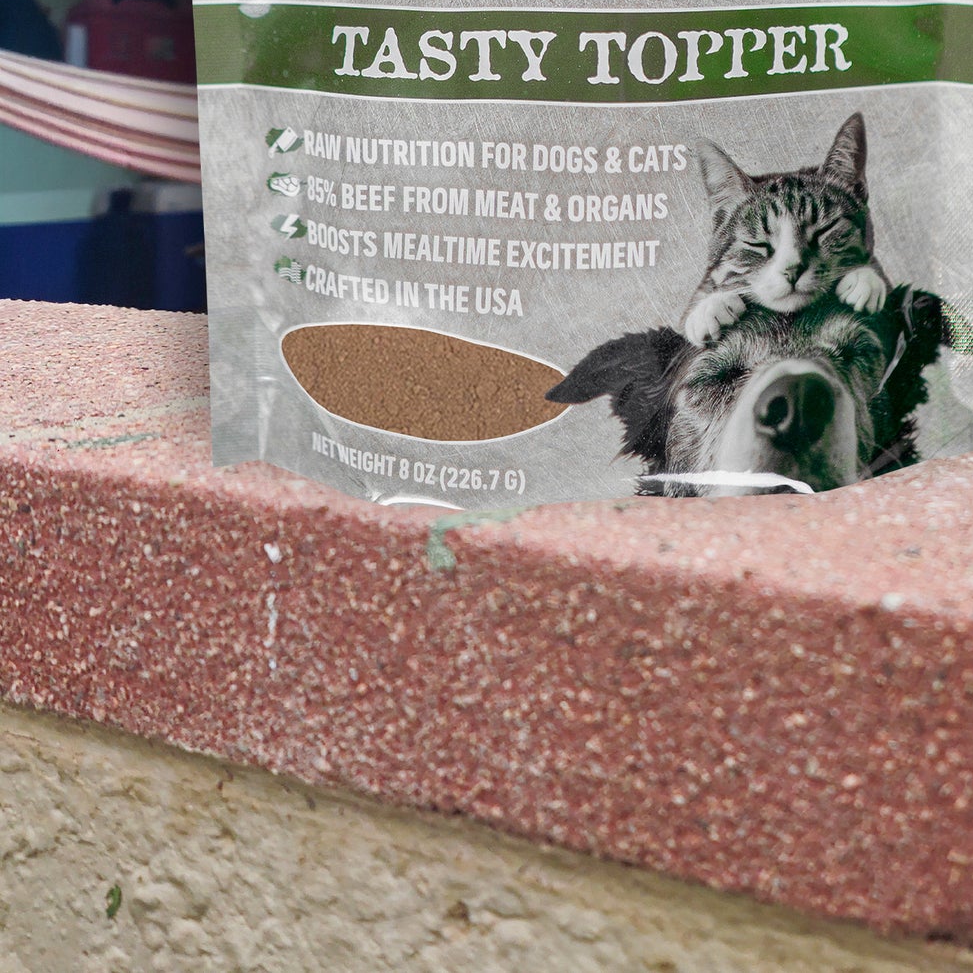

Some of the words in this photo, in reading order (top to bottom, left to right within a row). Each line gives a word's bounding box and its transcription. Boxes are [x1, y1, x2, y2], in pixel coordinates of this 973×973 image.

[331, 24, 557, 82] TASTY
[578, 23, 853, 85] TOPPER
[303, 129, 341, 161] RAW
[346, 136, 474, 168] NUTRITION
[482, 141, 527, 170] FOR
[532, 144, 598, 172] DOGS
[604, 147, 622, 173] &
[628, 144, 687, 173] CATS
[307, 175, 337, 207] 85%
[341, 183, 396, 212] BEEF
[403, 186, 469, 216] FROM
[475, 189, 539, 220] MEAT
[545, 195, 562, 222] &
[568, 192, 669, 223] ORGANS
[307, 219, 378, 258] BOOSTS
[383, 232, 500, 267] MEALTIME
[506, 239, 660, 270] EXCITEMENT
[305, 264, 390, 305] CRAFTED
[395, 280, 420, 308] IN
[424, 283, 470, 313] THE
[475, 287, 523, 317] USA
[312, 431, 336, 459] NET
[336, 443, 396, 477] WEIGHT
[399, 458, 410, 480] 8
[413, 461, 435, 485] OZ
[440, 465, 500, 492] (226.7
[504, 469, 526, 495] G)
